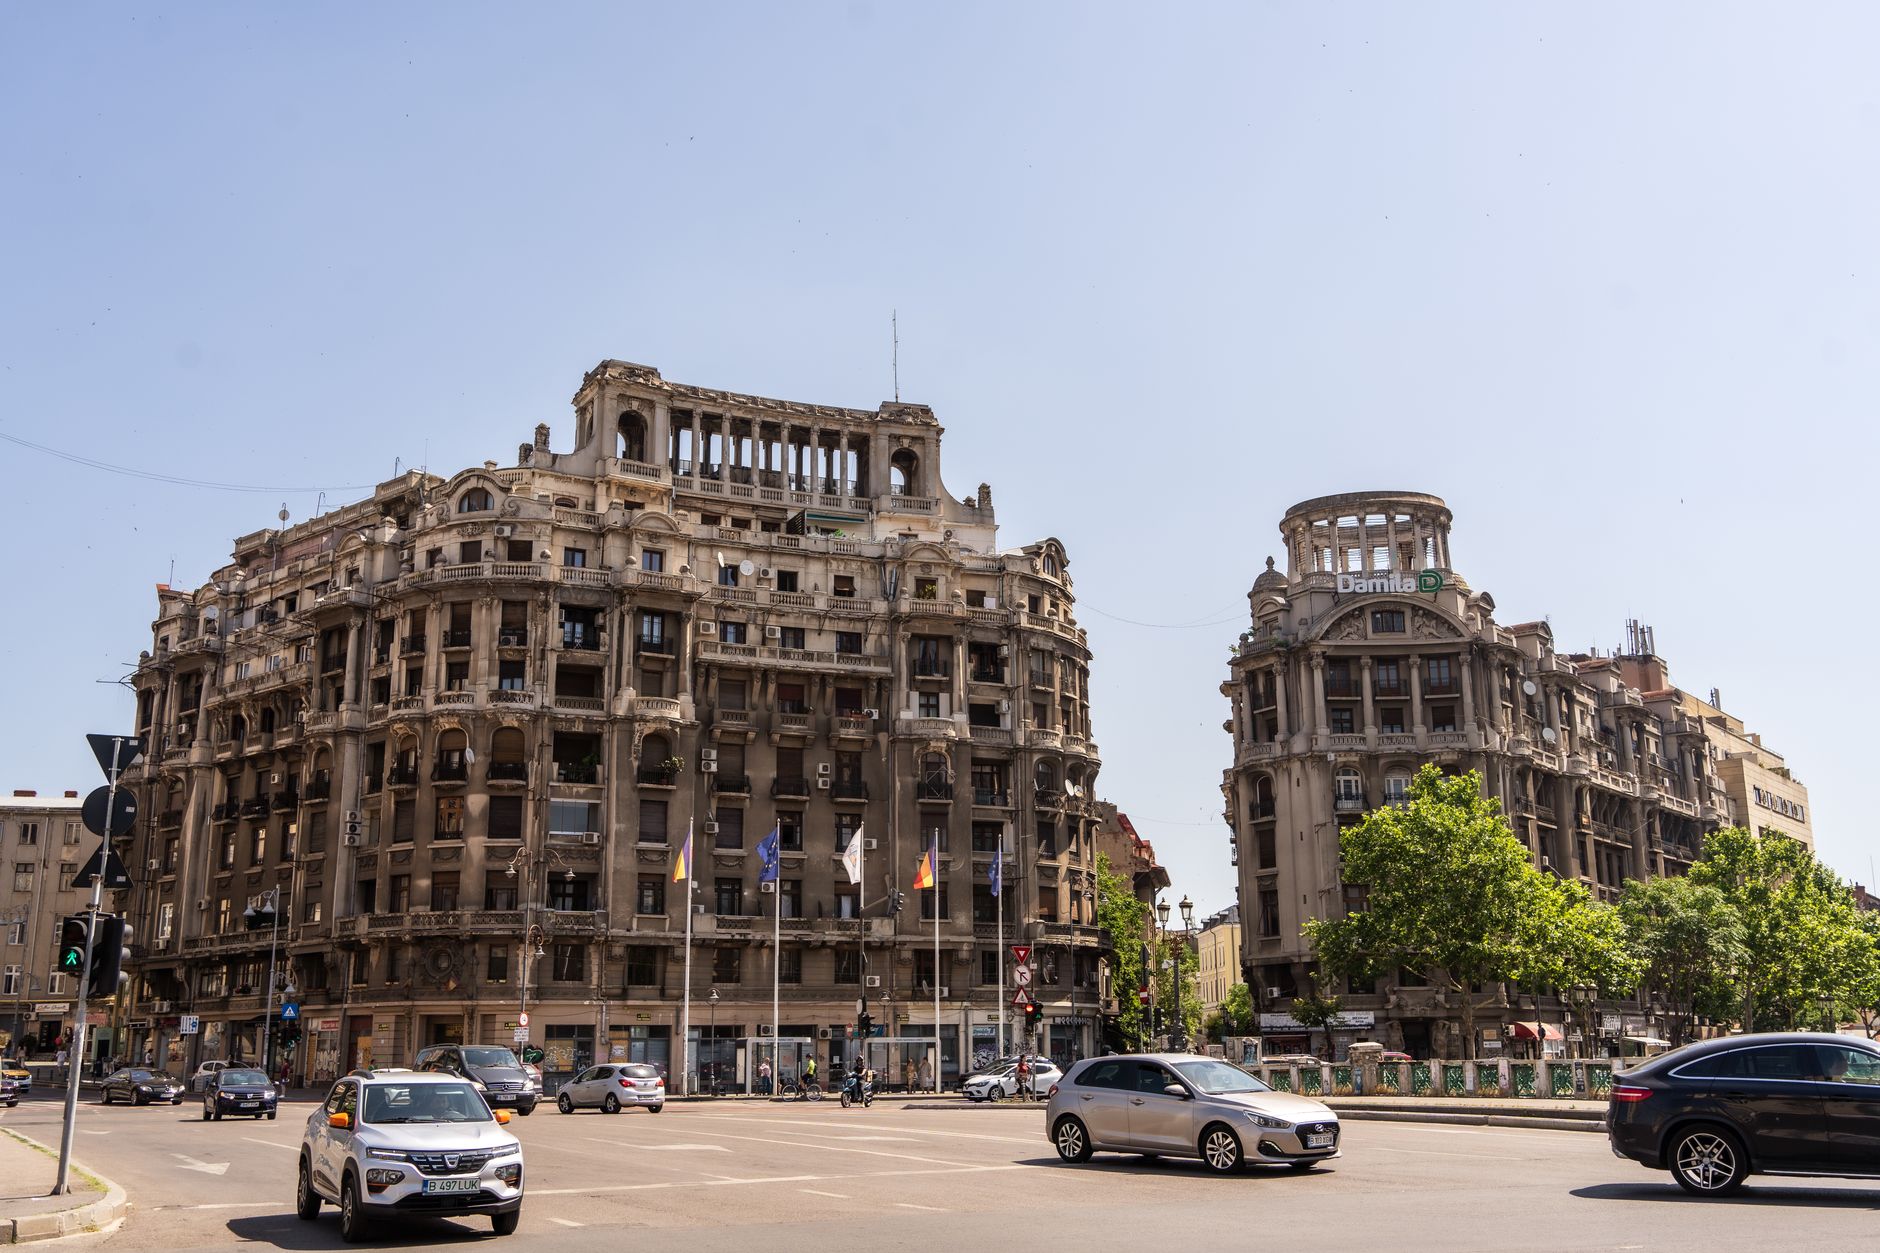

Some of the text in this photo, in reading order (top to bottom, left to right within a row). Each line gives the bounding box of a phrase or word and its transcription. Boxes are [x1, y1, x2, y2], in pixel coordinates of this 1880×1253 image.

[1337, 571, 1416, 593] Damila
[429, 1180, 478, 1191] B 497 LUK
